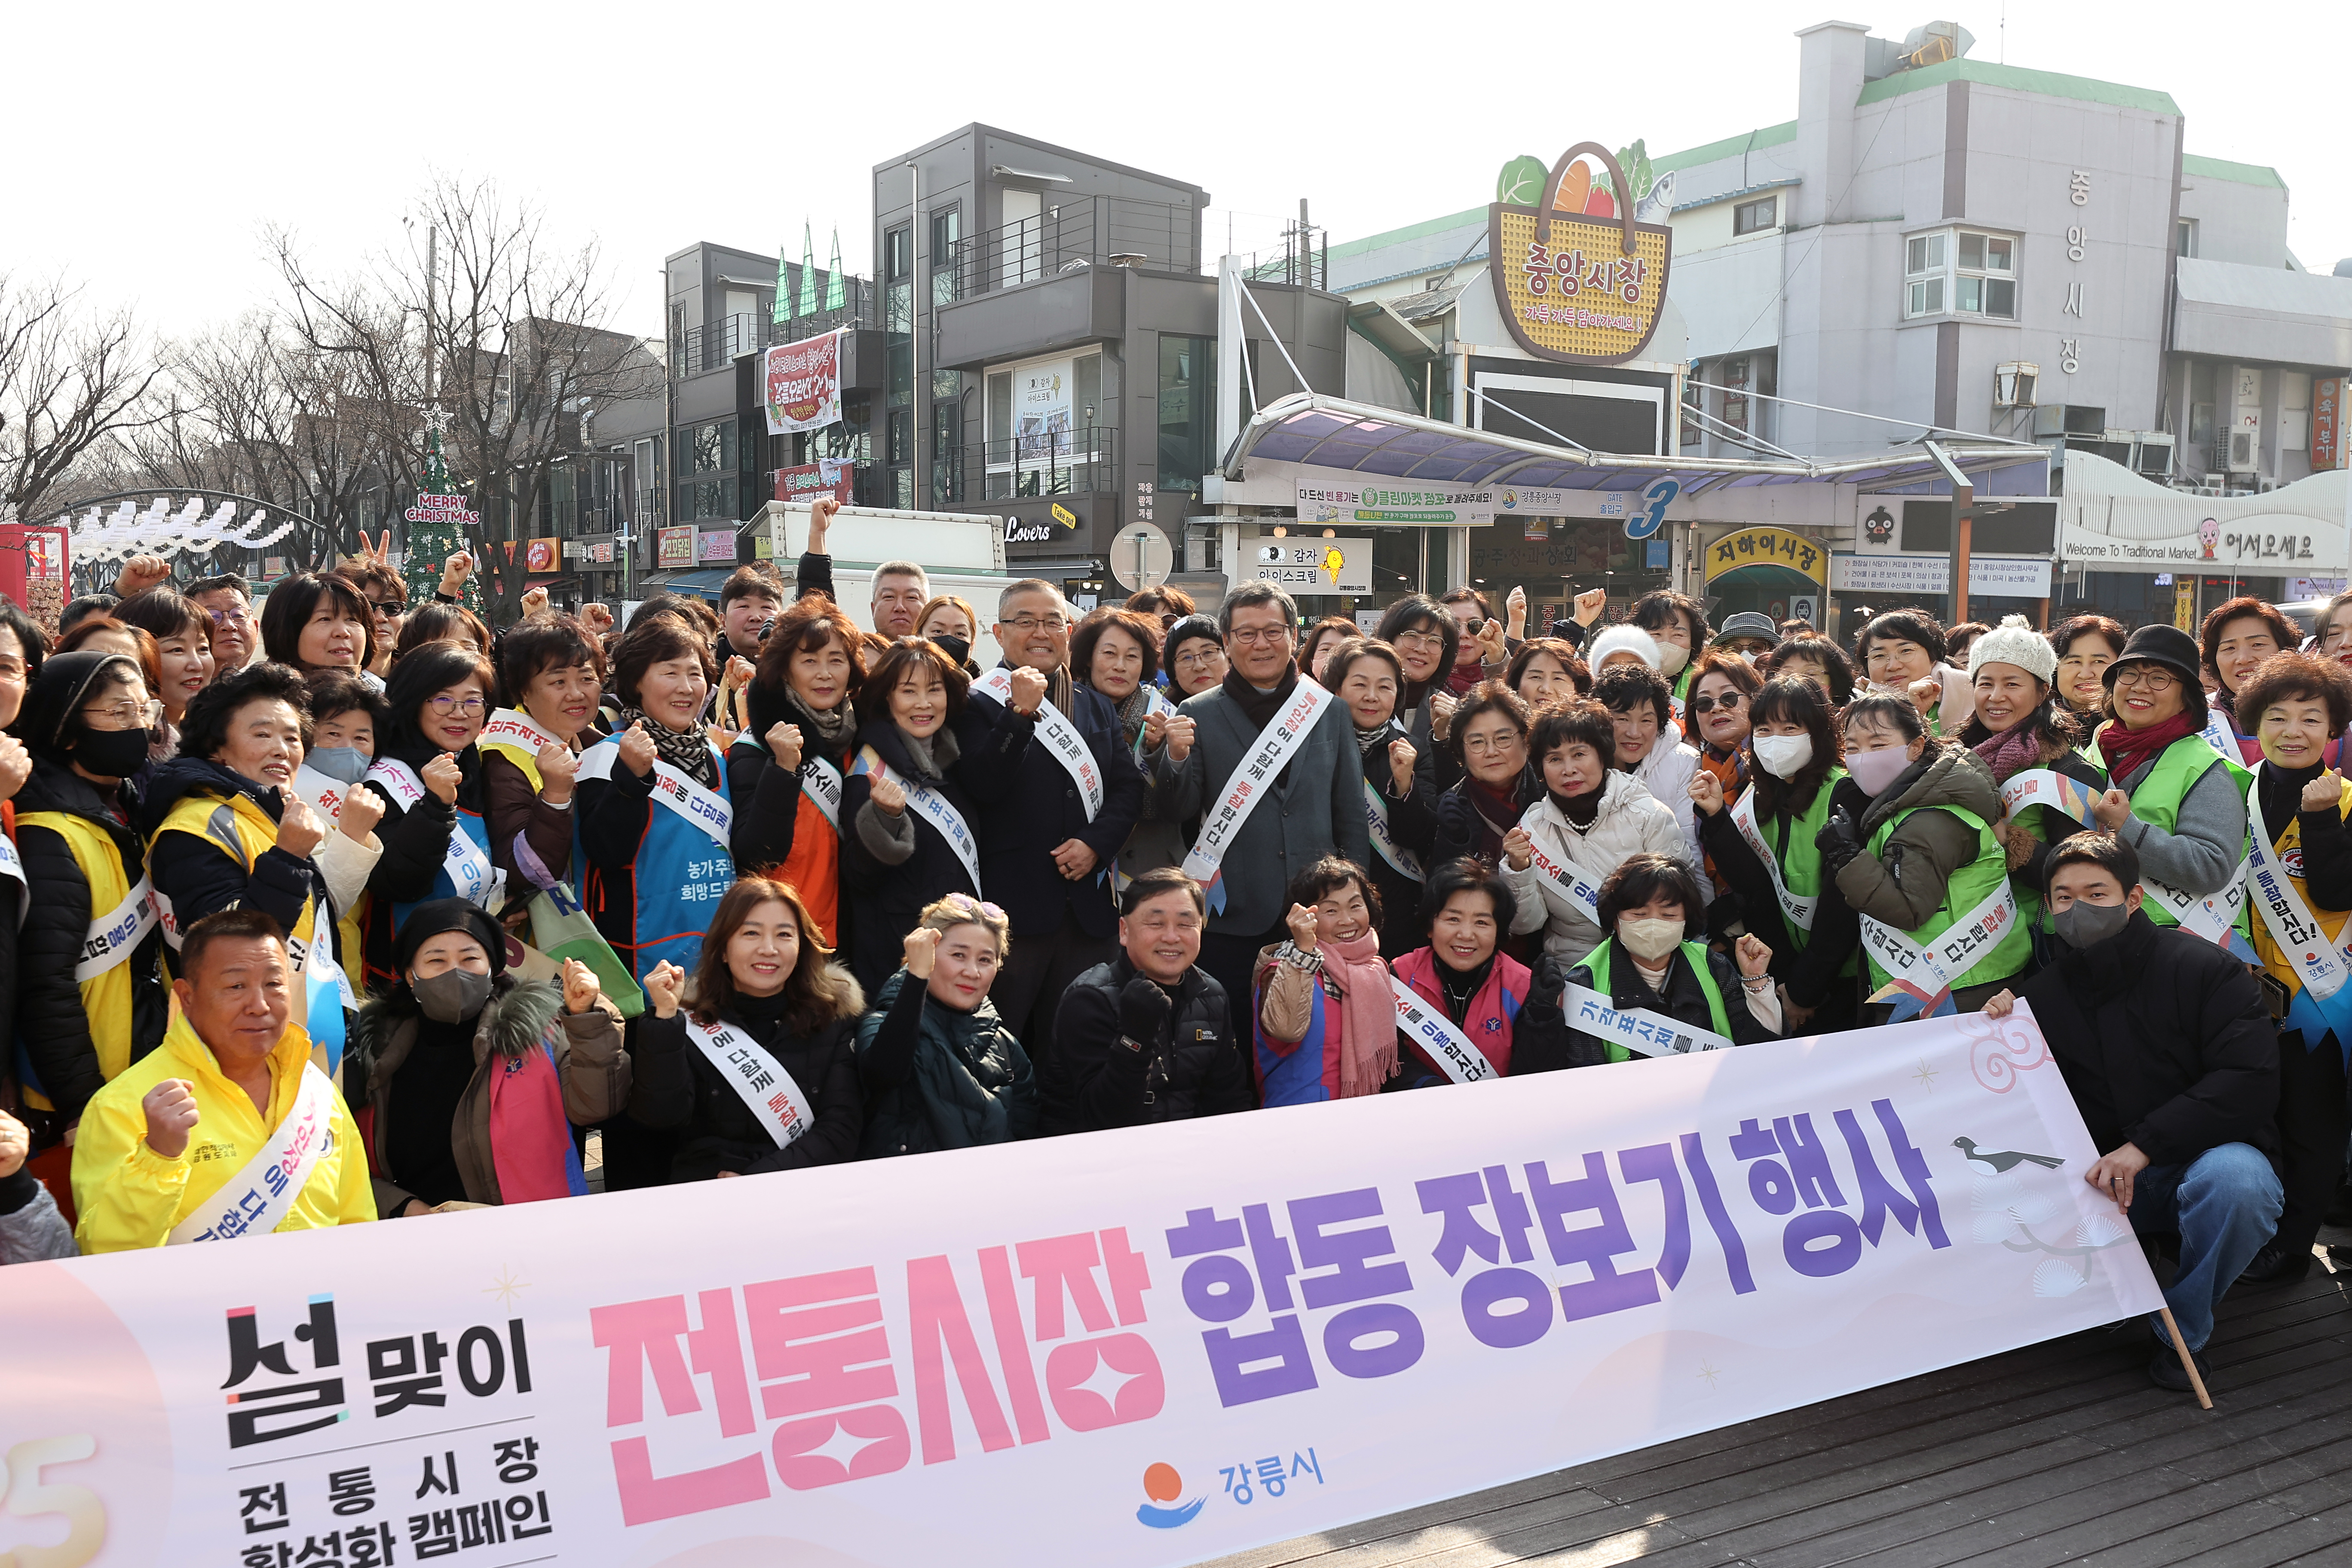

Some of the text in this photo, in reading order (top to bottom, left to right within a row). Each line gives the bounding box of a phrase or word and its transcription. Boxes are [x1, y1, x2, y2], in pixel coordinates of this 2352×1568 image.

[1522, 242, 1647, 304] 중앙시장
[2060, 169, 2091, 374] 중앙시장
[1525, 304, 1550, 325] 가득
[1551, 307, 1575, 327] 가득
[1040, 377, 1050, 387] 감자
[1027, 391, 1050, 404] 아이스크림
[785, 471, 820, 491] 강릉 크리스마스
[418, 494, 467, 509] MERRY
[1299, 489, 1307, 499] 다
[1309, 490, 1324, 501] 드신
[1326, 491, 1334, 502] 빈
[1335, 491, 1359, 503] 용기는
[1379, 490, 1422, 506] 클린마켓
[1454, 492, 1492, 504] 돌려주세요!
[1521, 490, 1562, 504] 강릉중앙시장
[1599, 504, 1622, 514] 출입구
[1608, 493, 1622, 502] GATE
[1625, 476, 1681, 539] 3
[405, 508, 480, 524] CHRISTMAS
[1004, 516, 1050, 542] Lovers
[1054, 505, 1075, 527] Take out
[709, 544, 720, 558] 순두부
[1294, 548, 1317, 563] 감자
[1717, 534, 1817, 571] 지하어시장
[2065, 542, 2197, 559] Welcome To Traditional Market
[2225, 533, 2315, 560] 어서오세요
[1259, 569, 1317, 584] 아이스크림
[1046, 723, 1083, 762] 다함께
[1204, 691, 1318, 848] 물가안정에 다함께 동참합시다
[690, 794, 729, 830] 다함께
[2256, 869, 2317, 946] 동참합시다!
[1943, 903, 2008, 964] 동참합시다
[2307, 961, 2334, 978] 강릉시
[1579, 1000, 1693, 1053] 가격표시제를
[1421, 1020, 1488, 1082] 이용합시다!
[727, 1049, 775, 1093] 다함께
[589, 1097, 1952, 1528] 전통시장 합동 장보기 행사
[220, 1292, 533, 1449] 설 맞이
[1218, 1446, 1324, 1506] 강릉시
[407, 1489, 553, 1561] 캠페인
